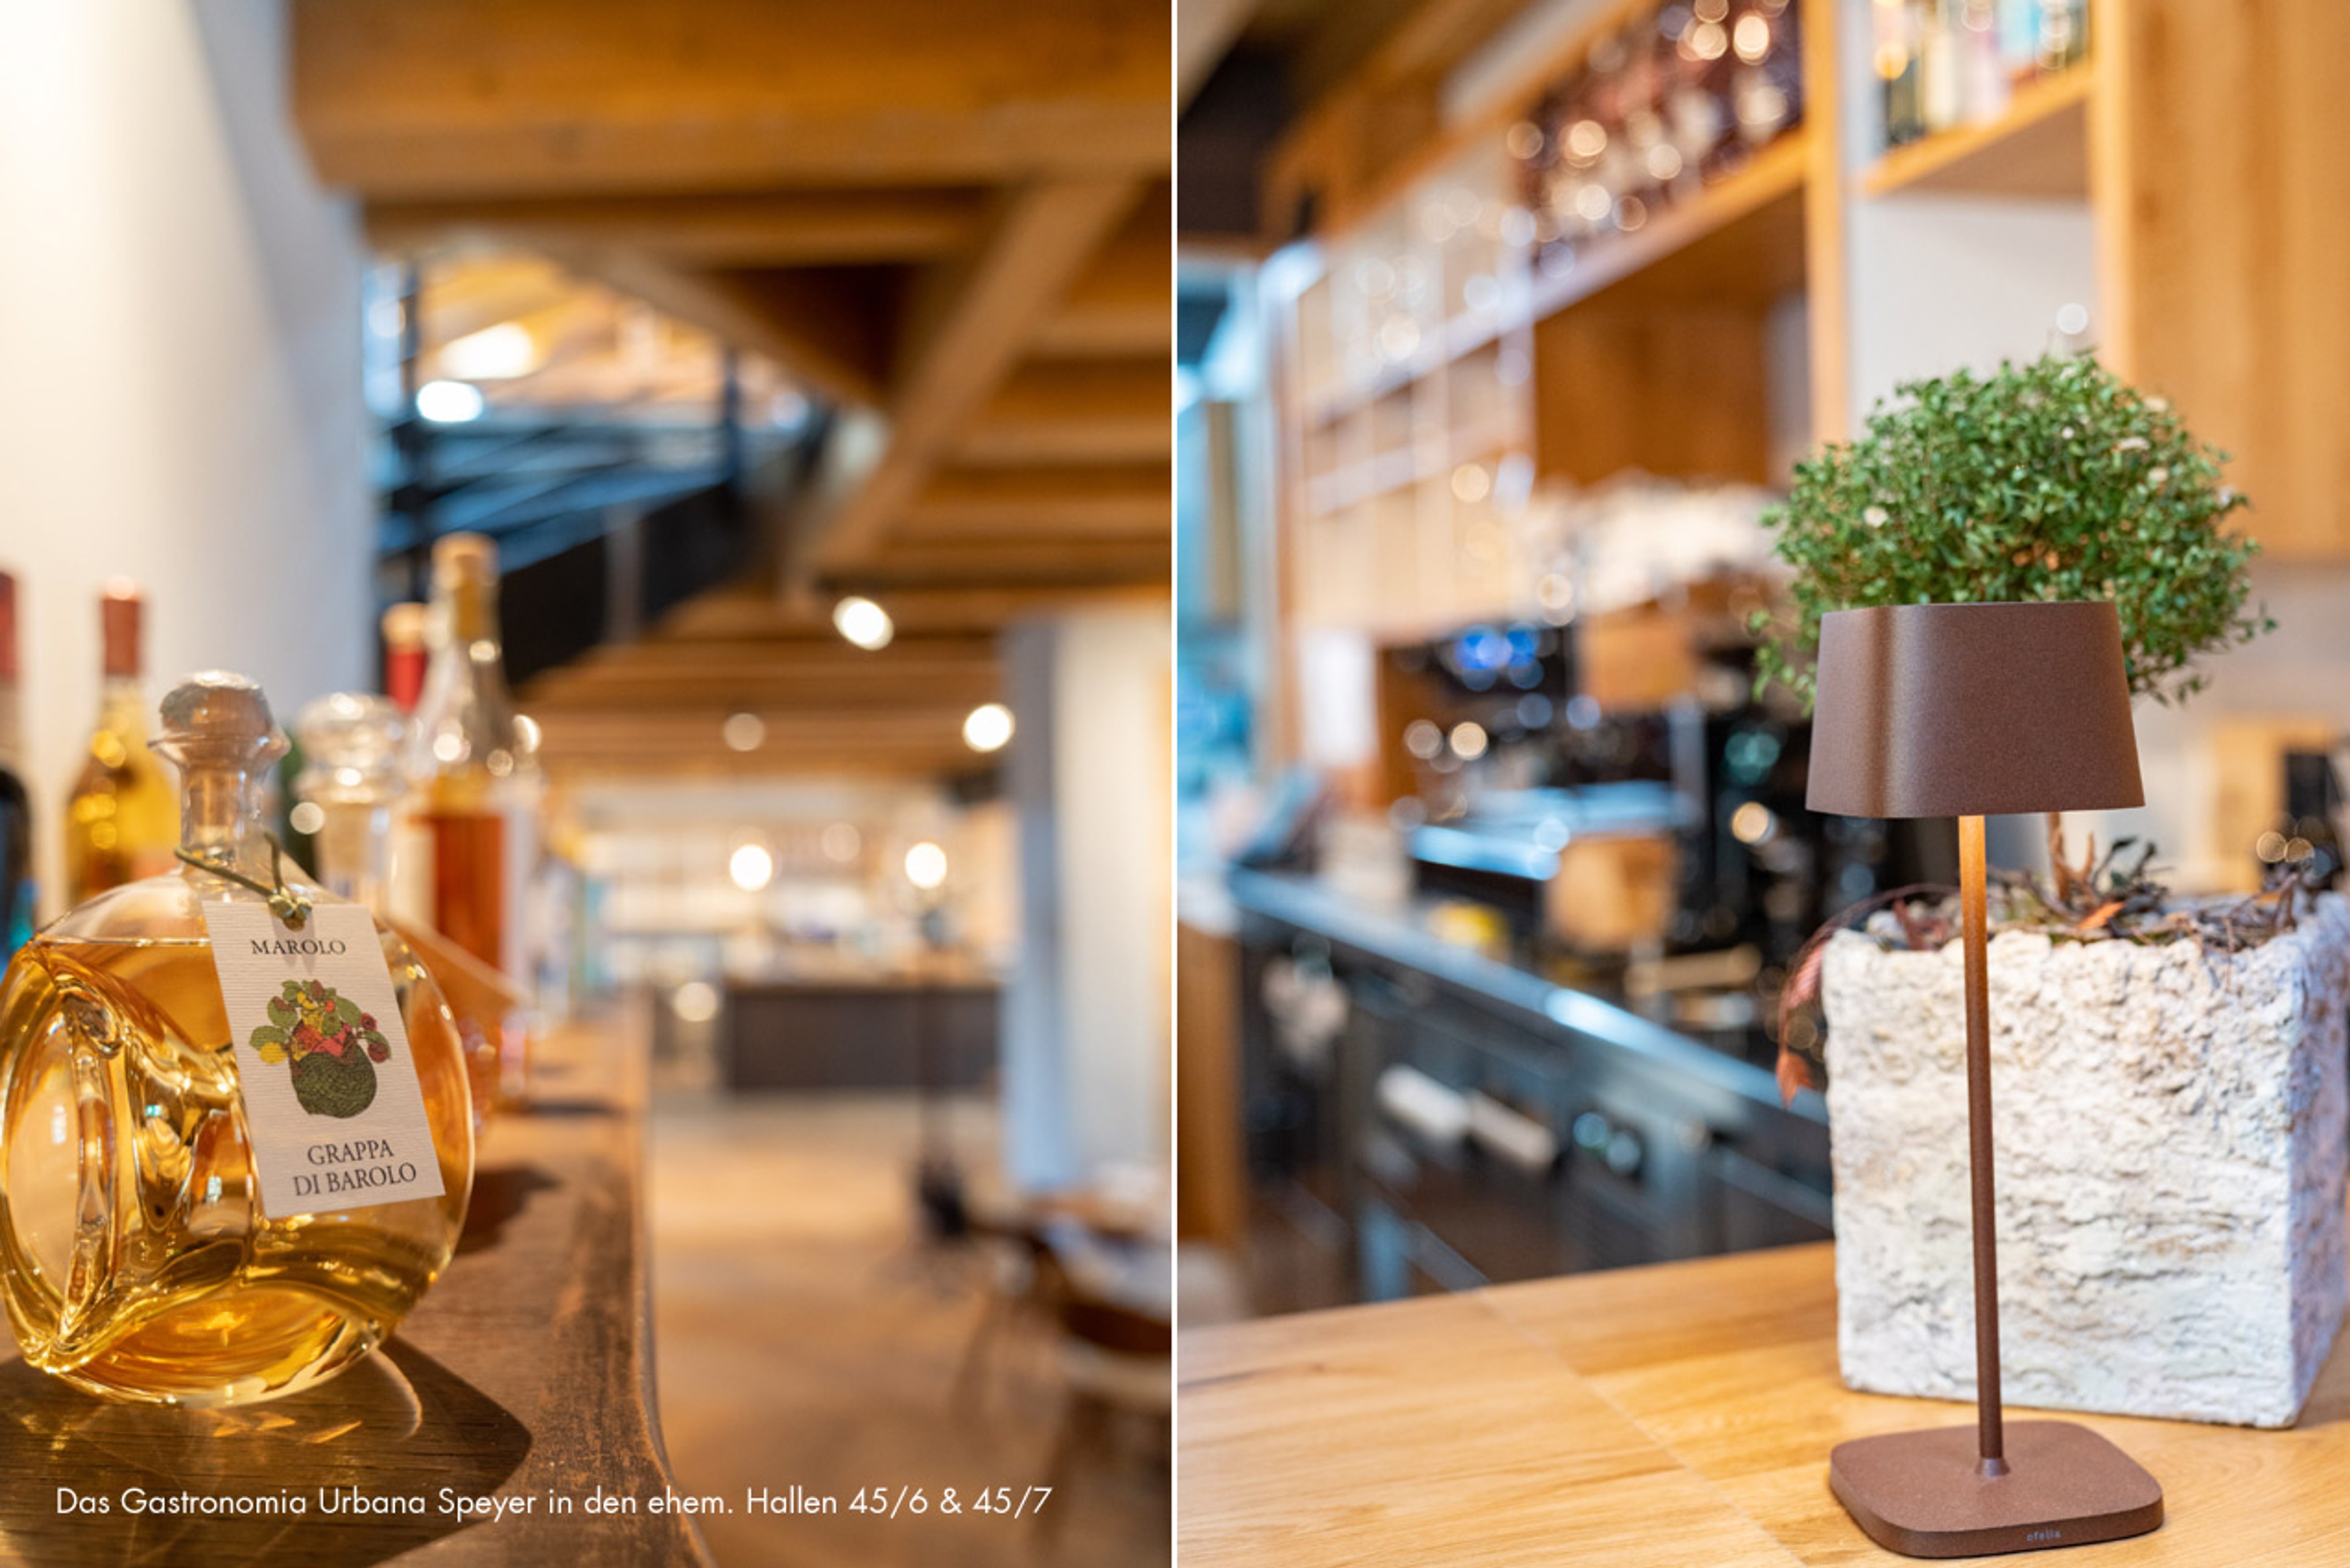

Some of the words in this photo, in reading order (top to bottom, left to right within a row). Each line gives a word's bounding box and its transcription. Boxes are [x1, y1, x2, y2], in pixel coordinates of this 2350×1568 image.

[251, 939, 346, 955] MAROLO
[308, 1139, 394, 1165] GRAPPA
[294, 1174, 321, 1196] DI
[326, 1162, 417, 1193] BAROLO
